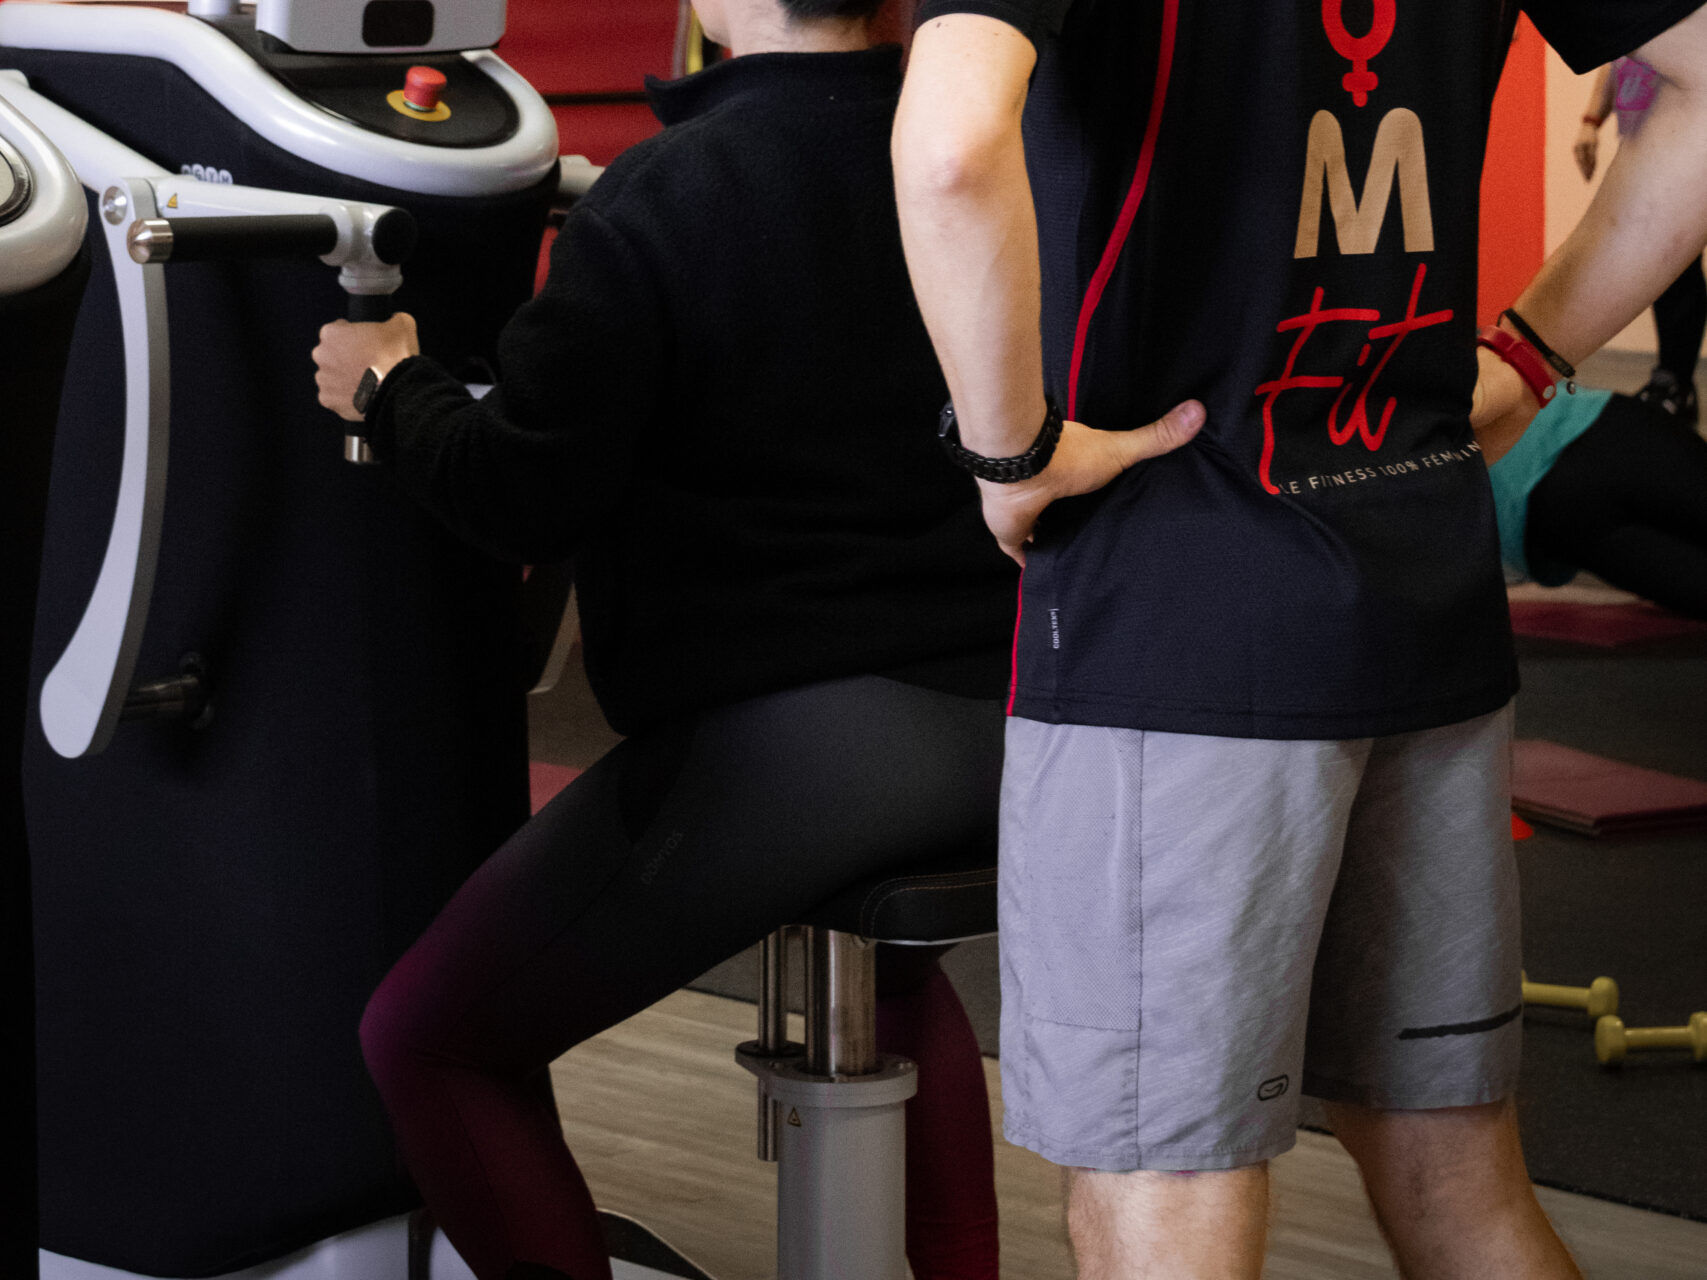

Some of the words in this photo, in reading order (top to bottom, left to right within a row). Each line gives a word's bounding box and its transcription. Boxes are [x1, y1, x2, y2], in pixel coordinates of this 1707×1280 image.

[1255, 263, 1454, 495] Fit
[1279, 480, 1302, 495] LE
[1378, 459, 1420, 476] 100%
[1421, 439, 1482, 469] FÉMNIN
